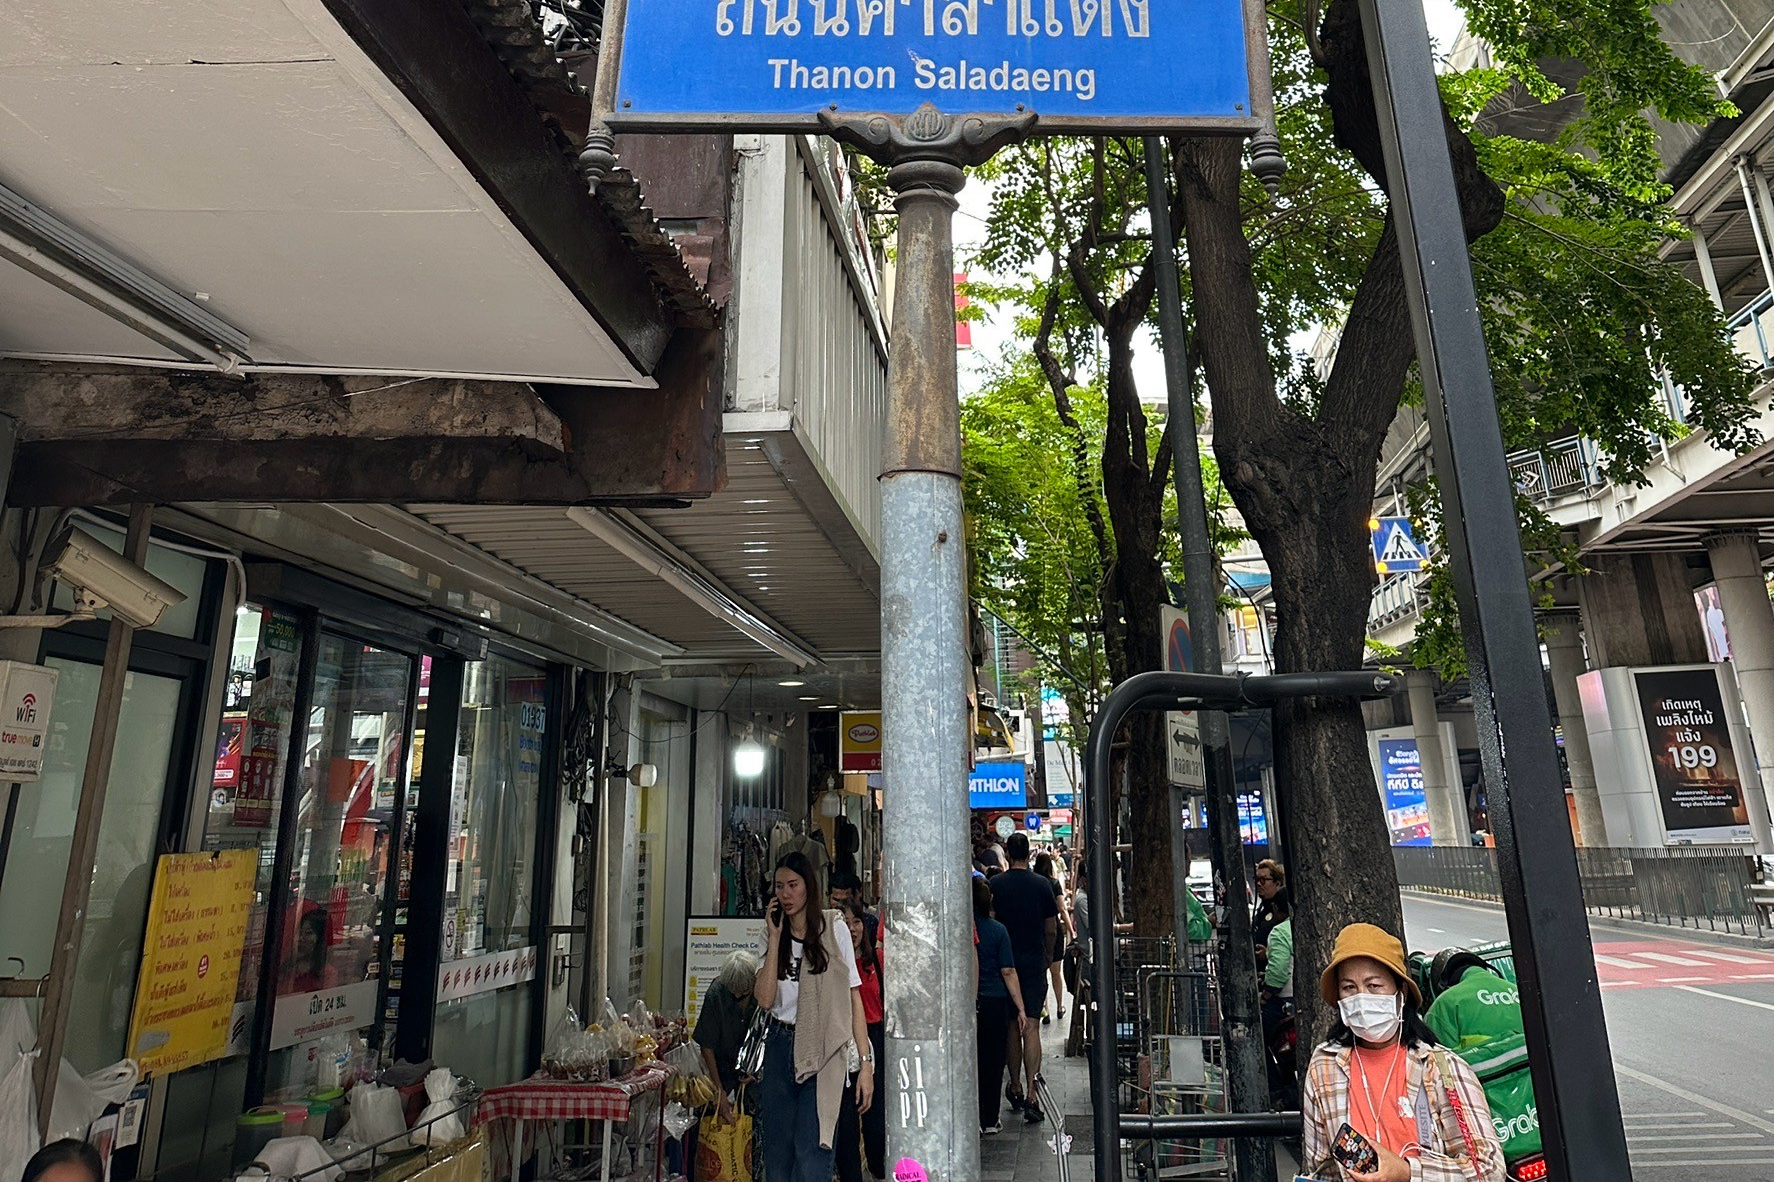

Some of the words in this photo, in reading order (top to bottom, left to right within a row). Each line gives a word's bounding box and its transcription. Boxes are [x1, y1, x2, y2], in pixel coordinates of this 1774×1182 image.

[768, 58, 896, 90] Thanon
[914, 57, 1097, 100] Saladaeng
[16, 705, 36, 723] WiFi
[1661, 699, 1702, 713] เกิดเหตุ
[1656, 710, 1714, 727] เพลิงไหม้
[1676, 728, 1702, 743] แจ้ง
[1668, 745, 1717, 769] 199
[969, 777, 1020, 793] ATHLON
[325, 997, 334, 1012] 24
